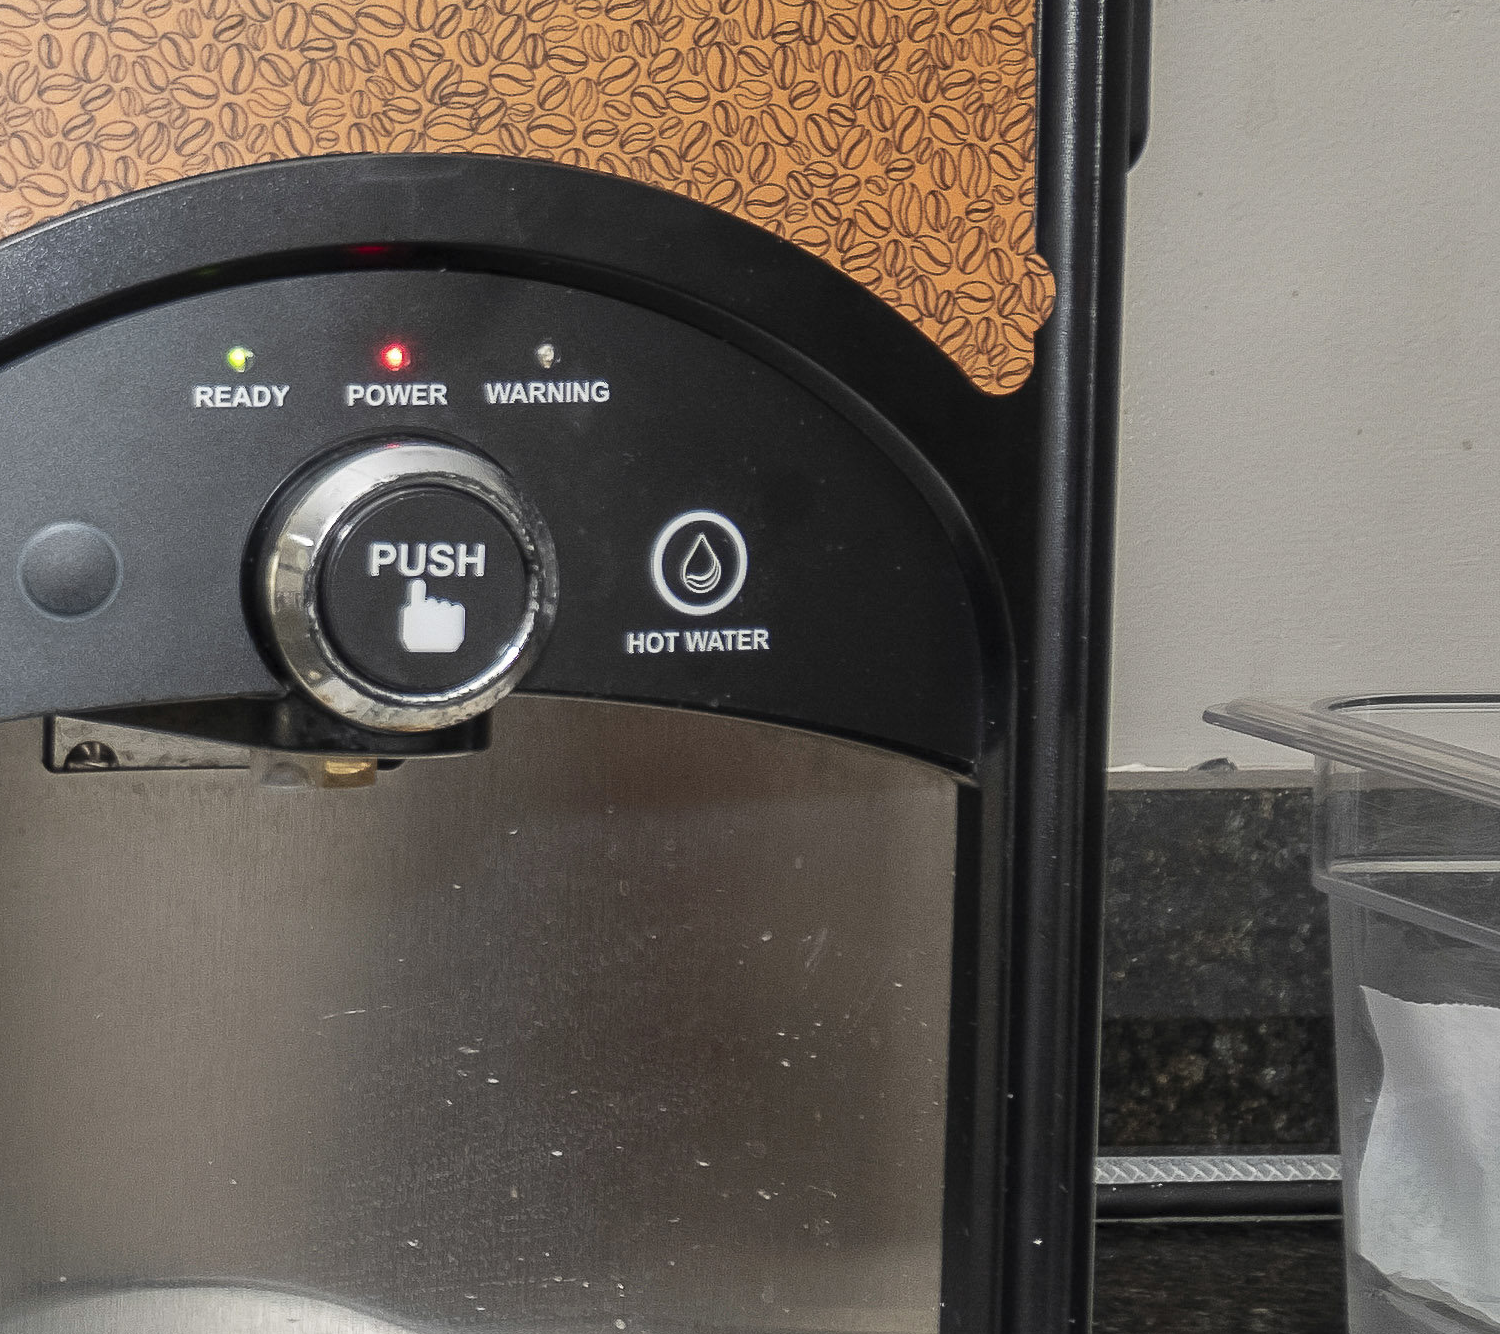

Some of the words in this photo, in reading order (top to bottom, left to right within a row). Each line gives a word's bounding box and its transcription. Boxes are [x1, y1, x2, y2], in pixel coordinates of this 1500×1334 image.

[194, 384, 290, 408] READY
[346, 383, 448, 407] POWER
[485, 380, 611, 405] WARNING
[368, 541, 487, 578] PUSH
[626, 631, 680, 654] HOT
[682, 629, 770, 653] WATER
